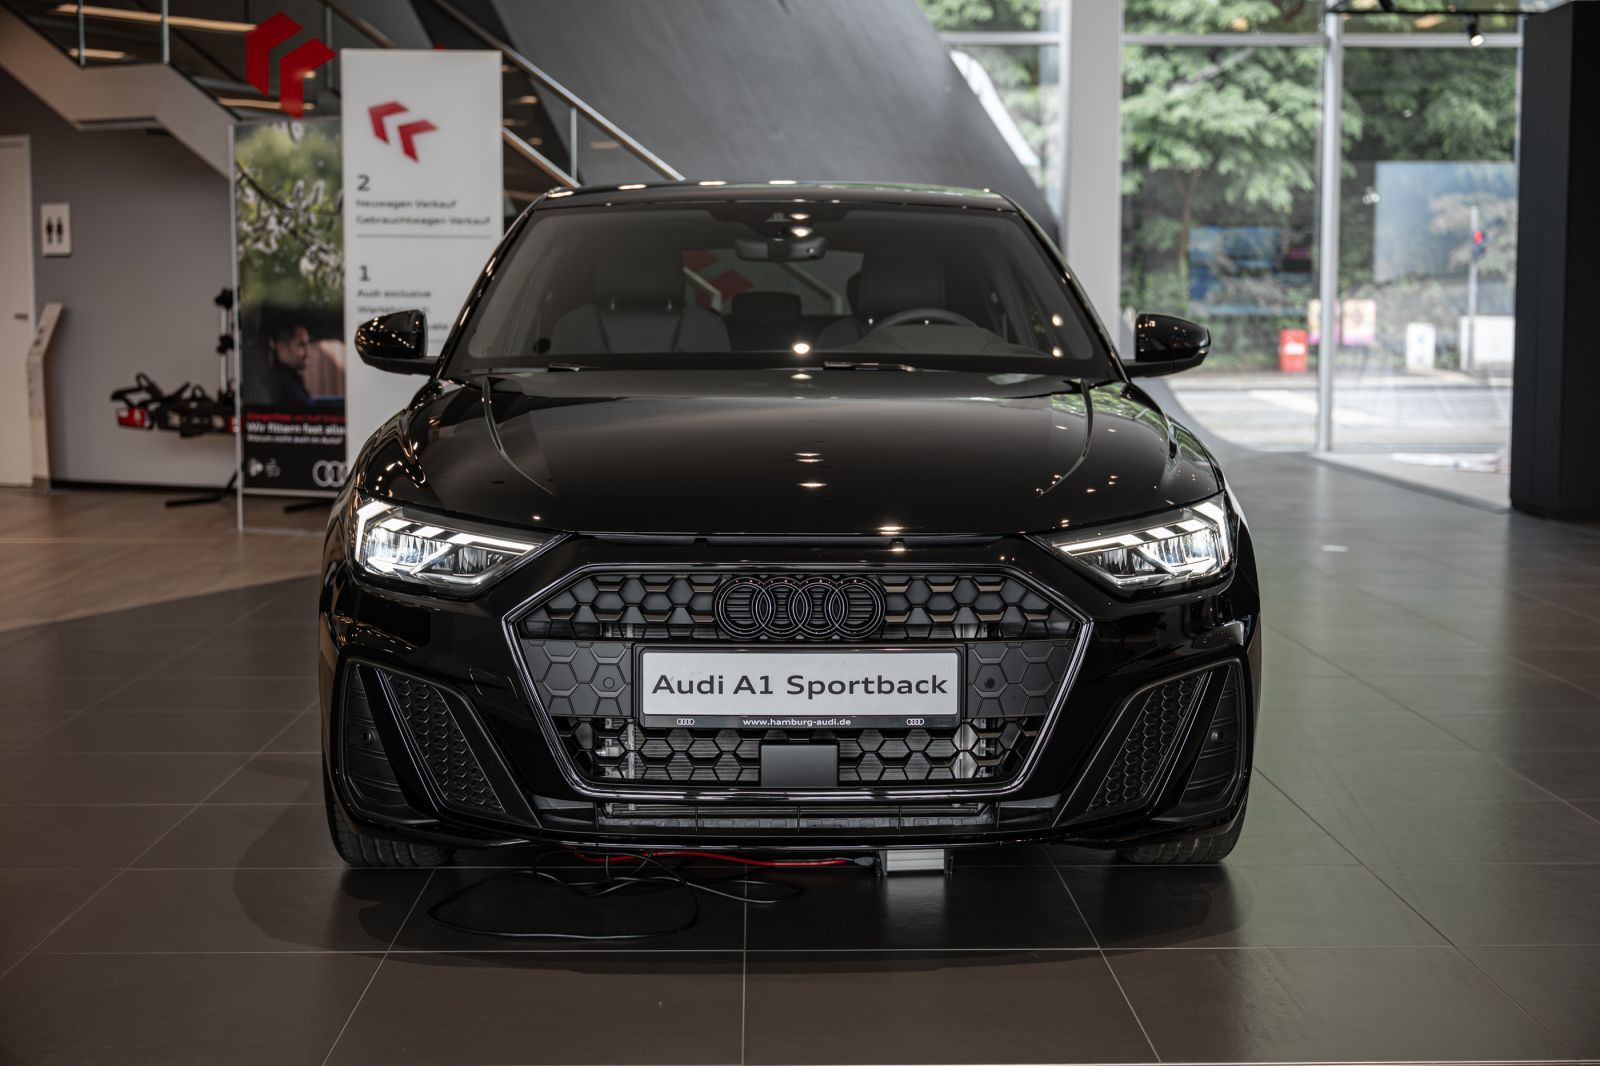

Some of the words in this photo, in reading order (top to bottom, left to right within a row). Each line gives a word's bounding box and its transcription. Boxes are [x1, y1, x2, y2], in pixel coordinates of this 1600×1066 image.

[357, 173, 371, 191] 2
[356, 199, 413, 210] Neuwagen
[415, 199, 457, 209] Verkauf
[356, 215, 447, 227] Gebrauchtwagen
[449, 216, 490, 226] Verkauf
[359, 265, 371, 282] 1
[357, 289, 380, 298] Audi
[383, 290, 431, 299] exclusive
[651, 674, 725, 696] Audi
[732, 675, 774, 696] A1
[785, 674, 949, 700] Sportback
[742, 717, 852, 728] www.hamburg-audi.de
